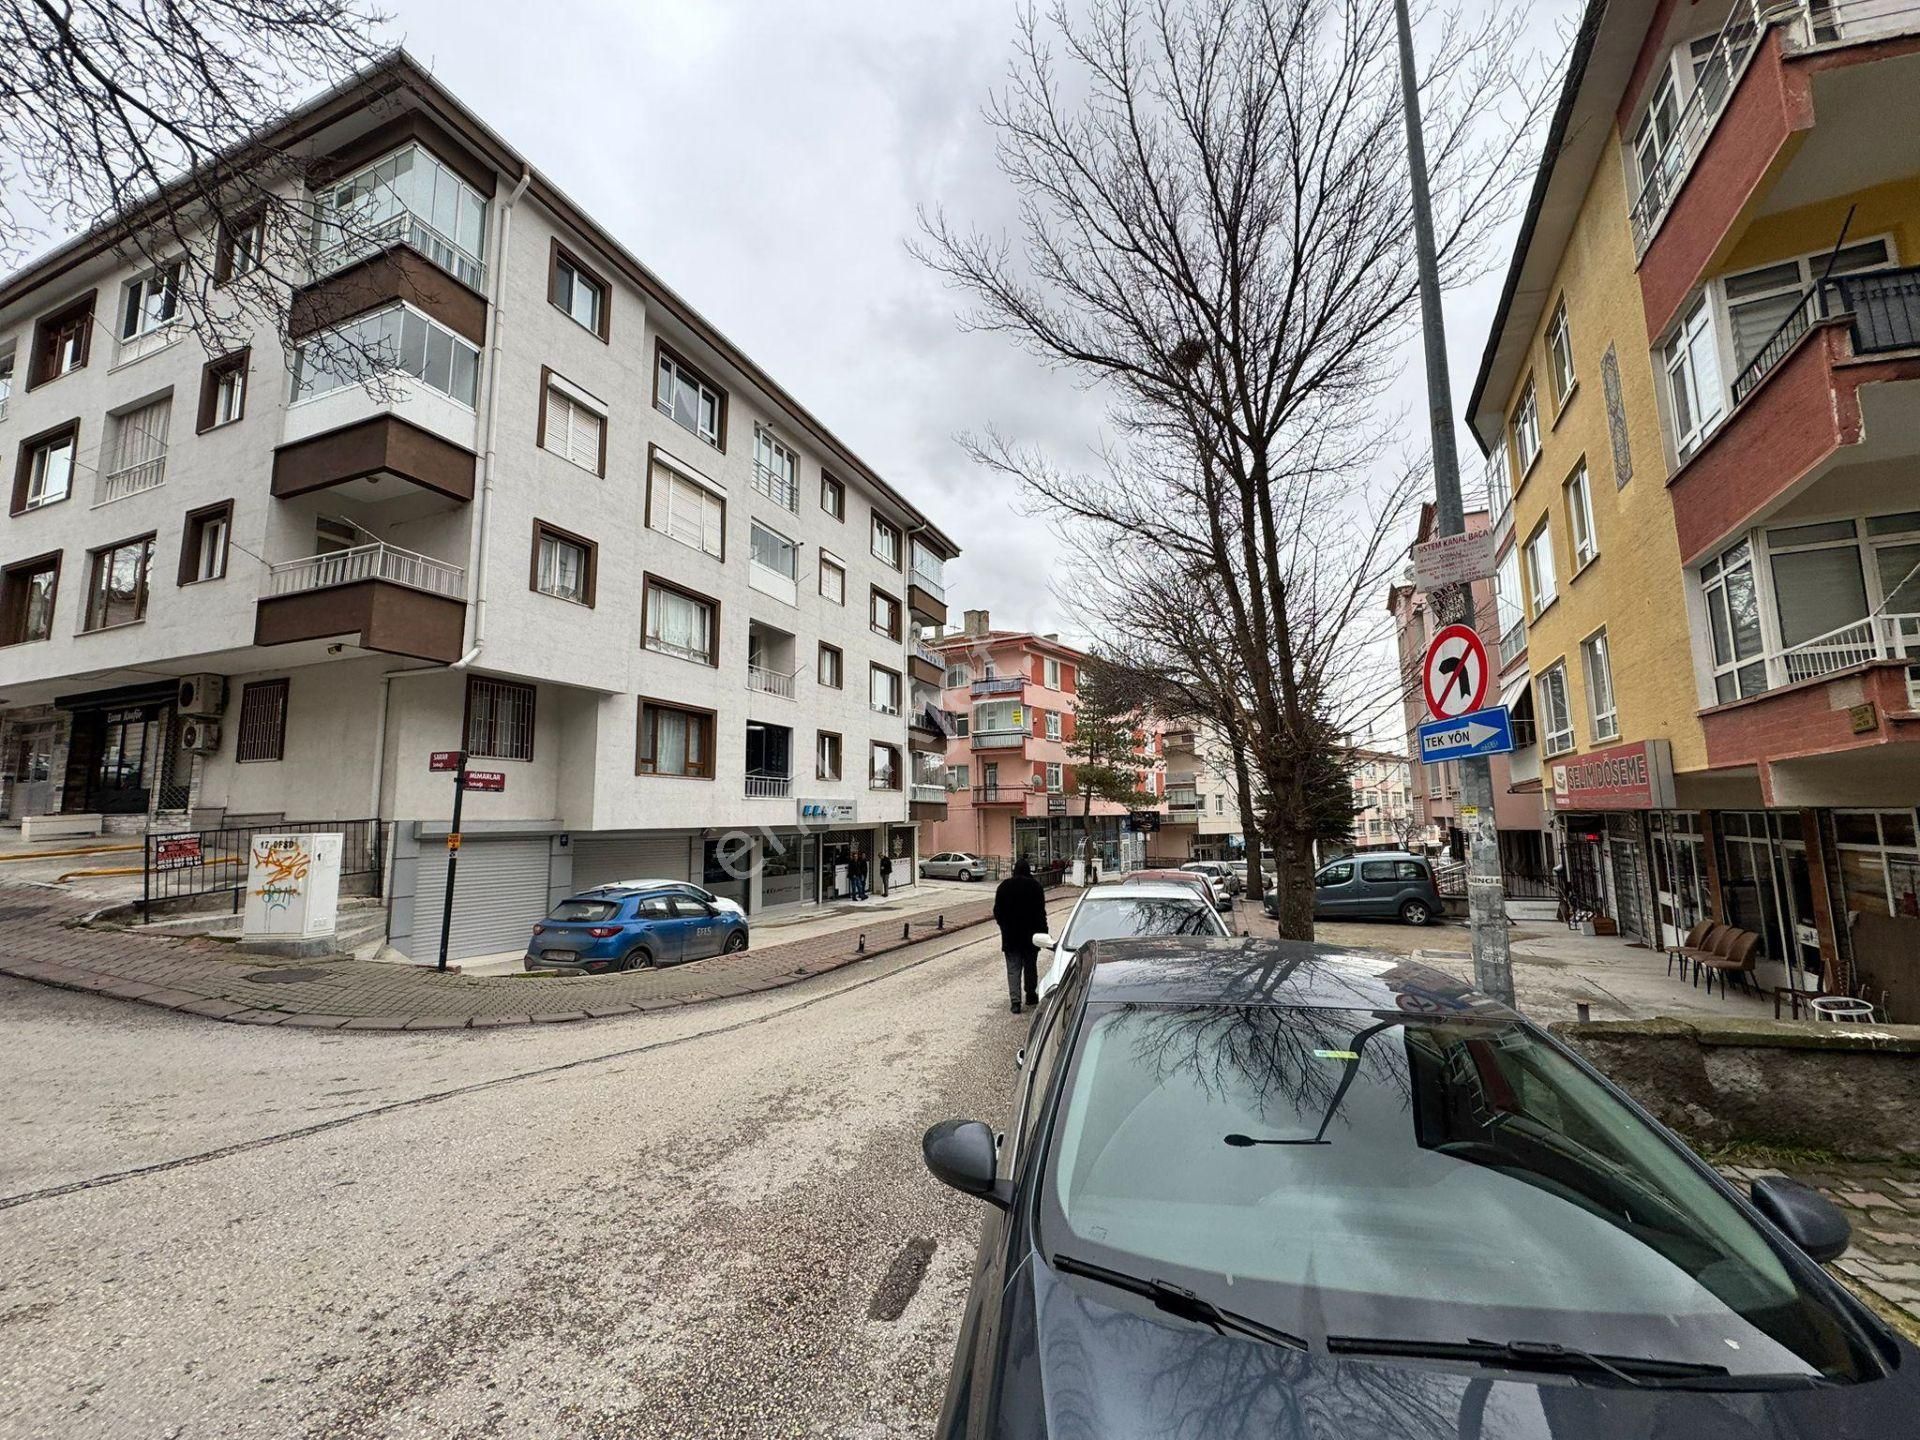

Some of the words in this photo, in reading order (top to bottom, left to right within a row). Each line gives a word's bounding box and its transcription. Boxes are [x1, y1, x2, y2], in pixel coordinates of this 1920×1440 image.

[1443, 535, 1467, 547] KANAL
[1425, 735, 1444, 748] TEK
[1448, 730, 1470, 744] YÖN
[1567, 759, 1595, 791] SELİM
[1598, 752, 1648, 793] DÖŞEME
